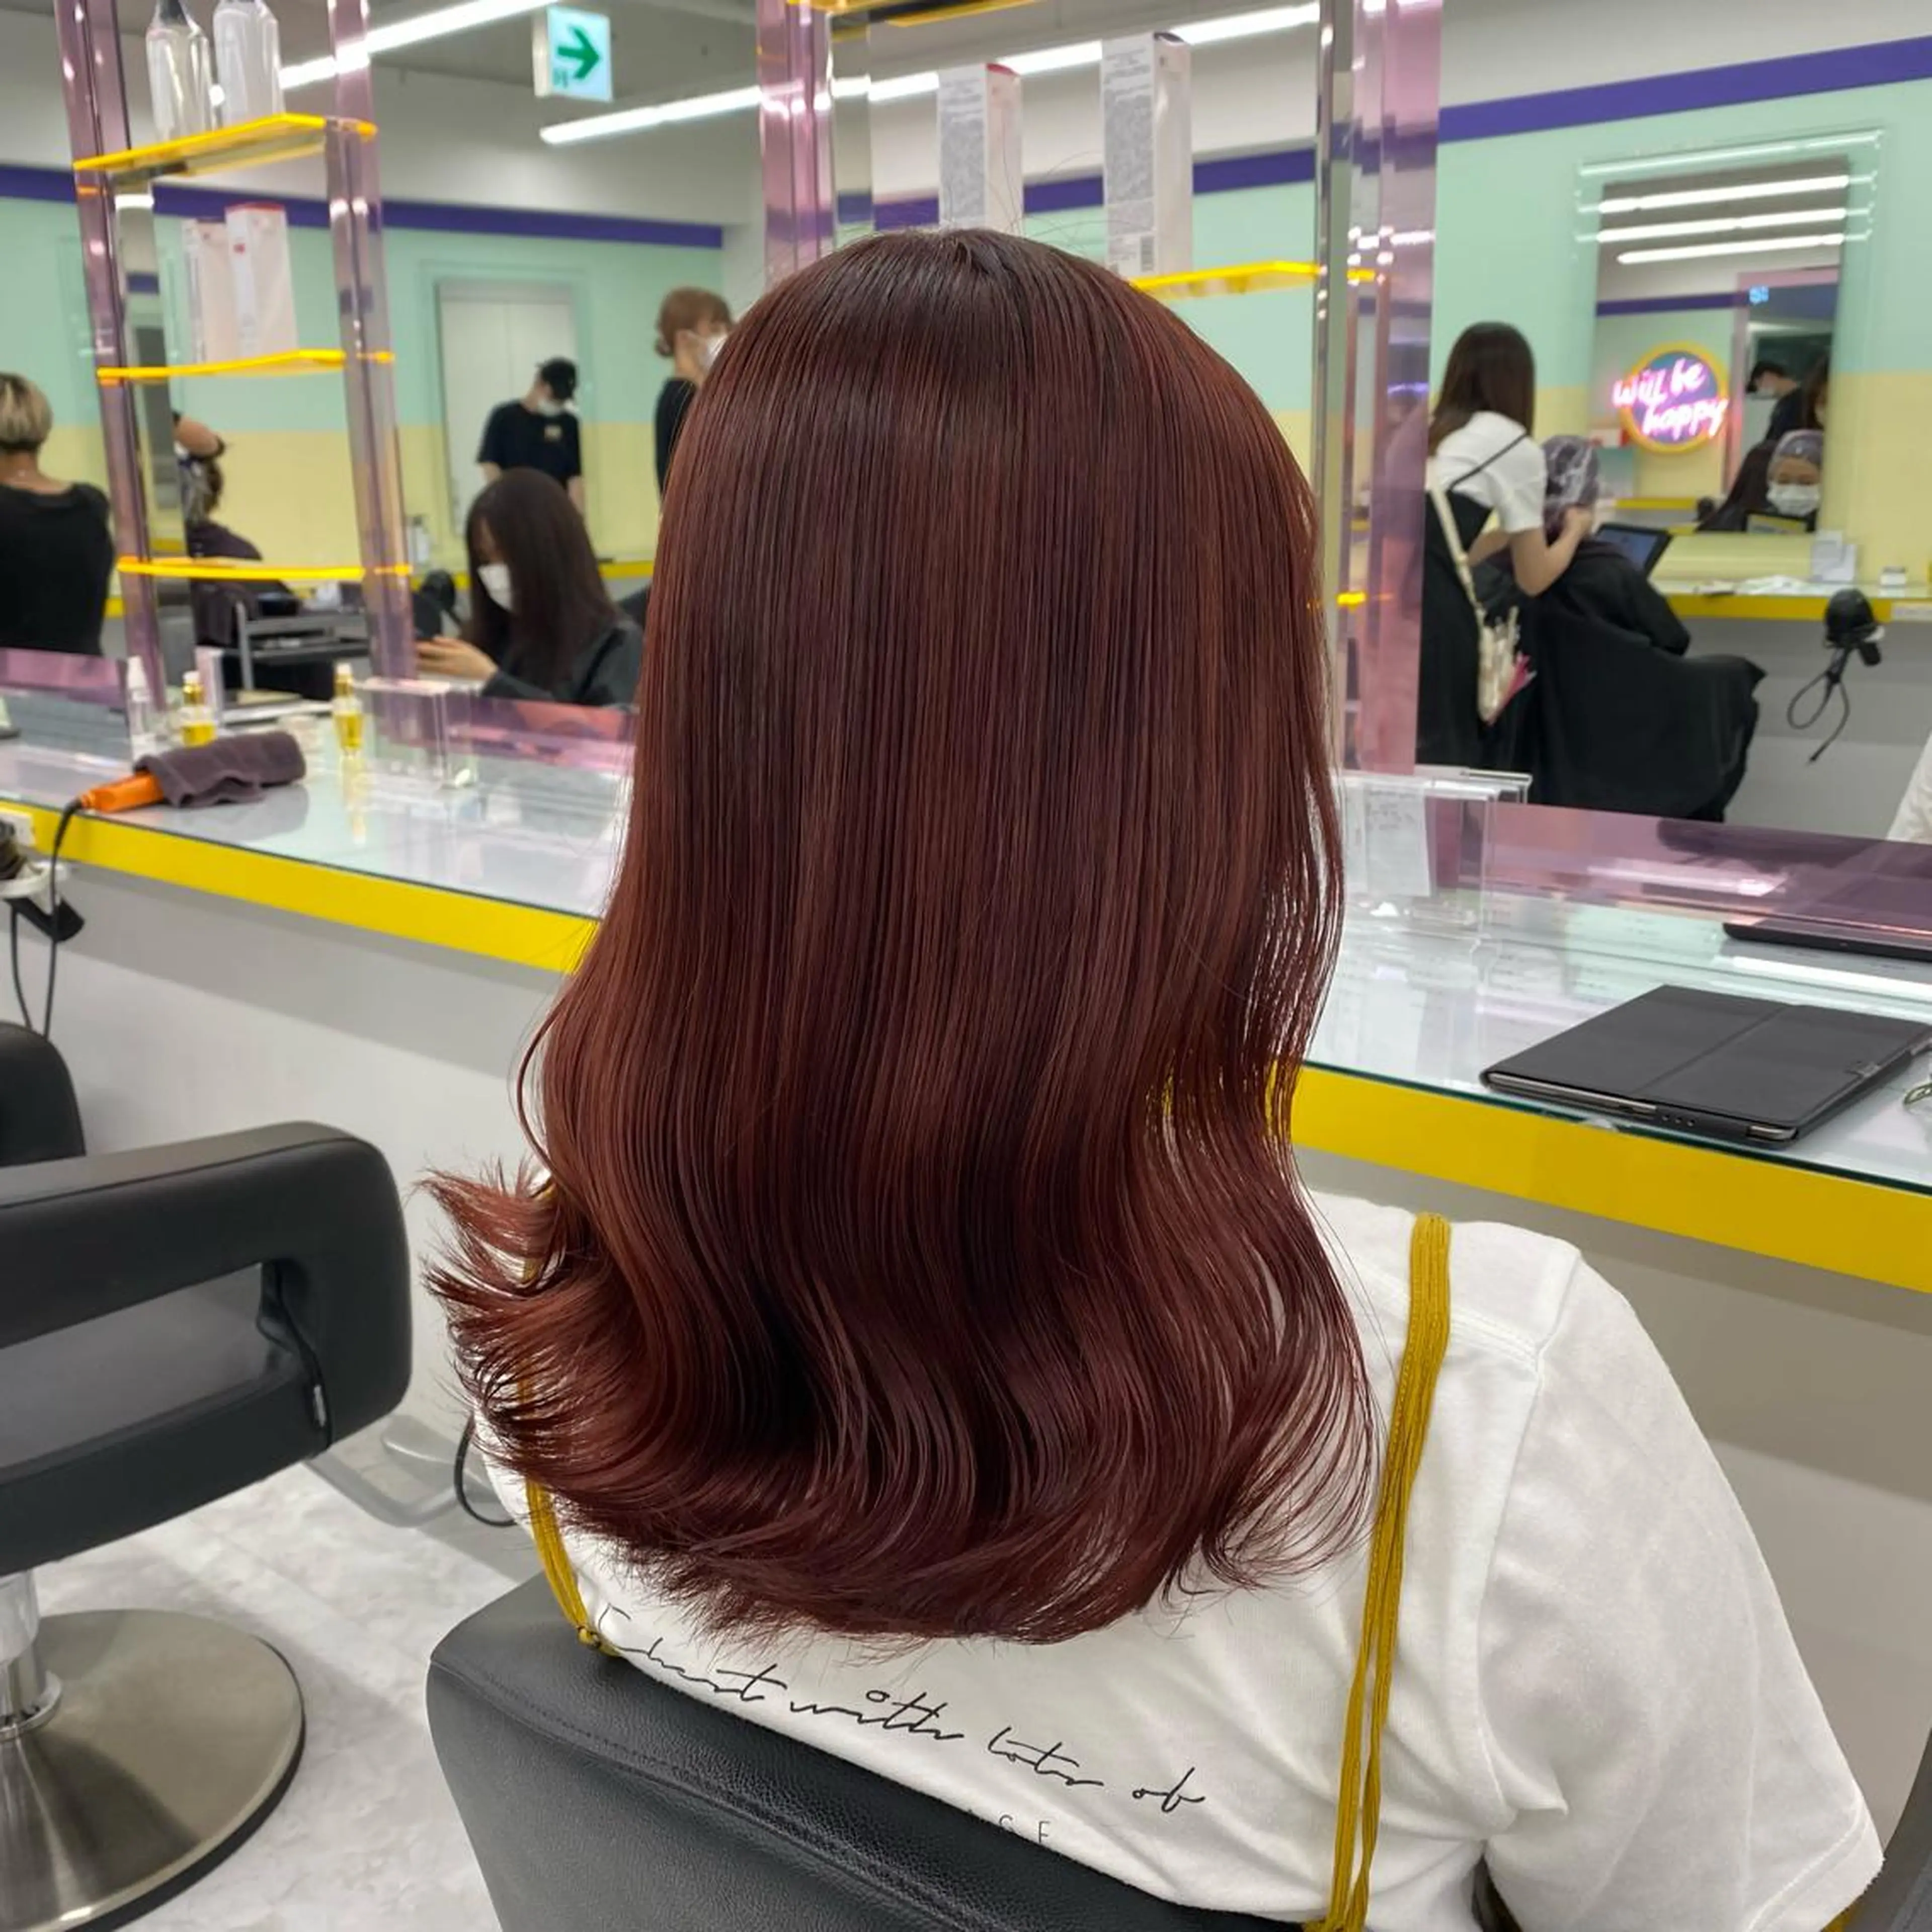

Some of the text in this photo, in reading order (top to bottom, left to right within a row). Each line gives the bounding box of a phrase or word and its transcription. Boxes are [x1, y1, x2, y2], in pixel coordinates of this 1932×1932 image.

[1612, 357, 1708, 409] will be
[1641, 397, 1730, 440] happy
[790, 1690, 964, 1740] with
[987, 1726, 1104, 1786] lots
[1132, 1766, 1205, 1812] of
